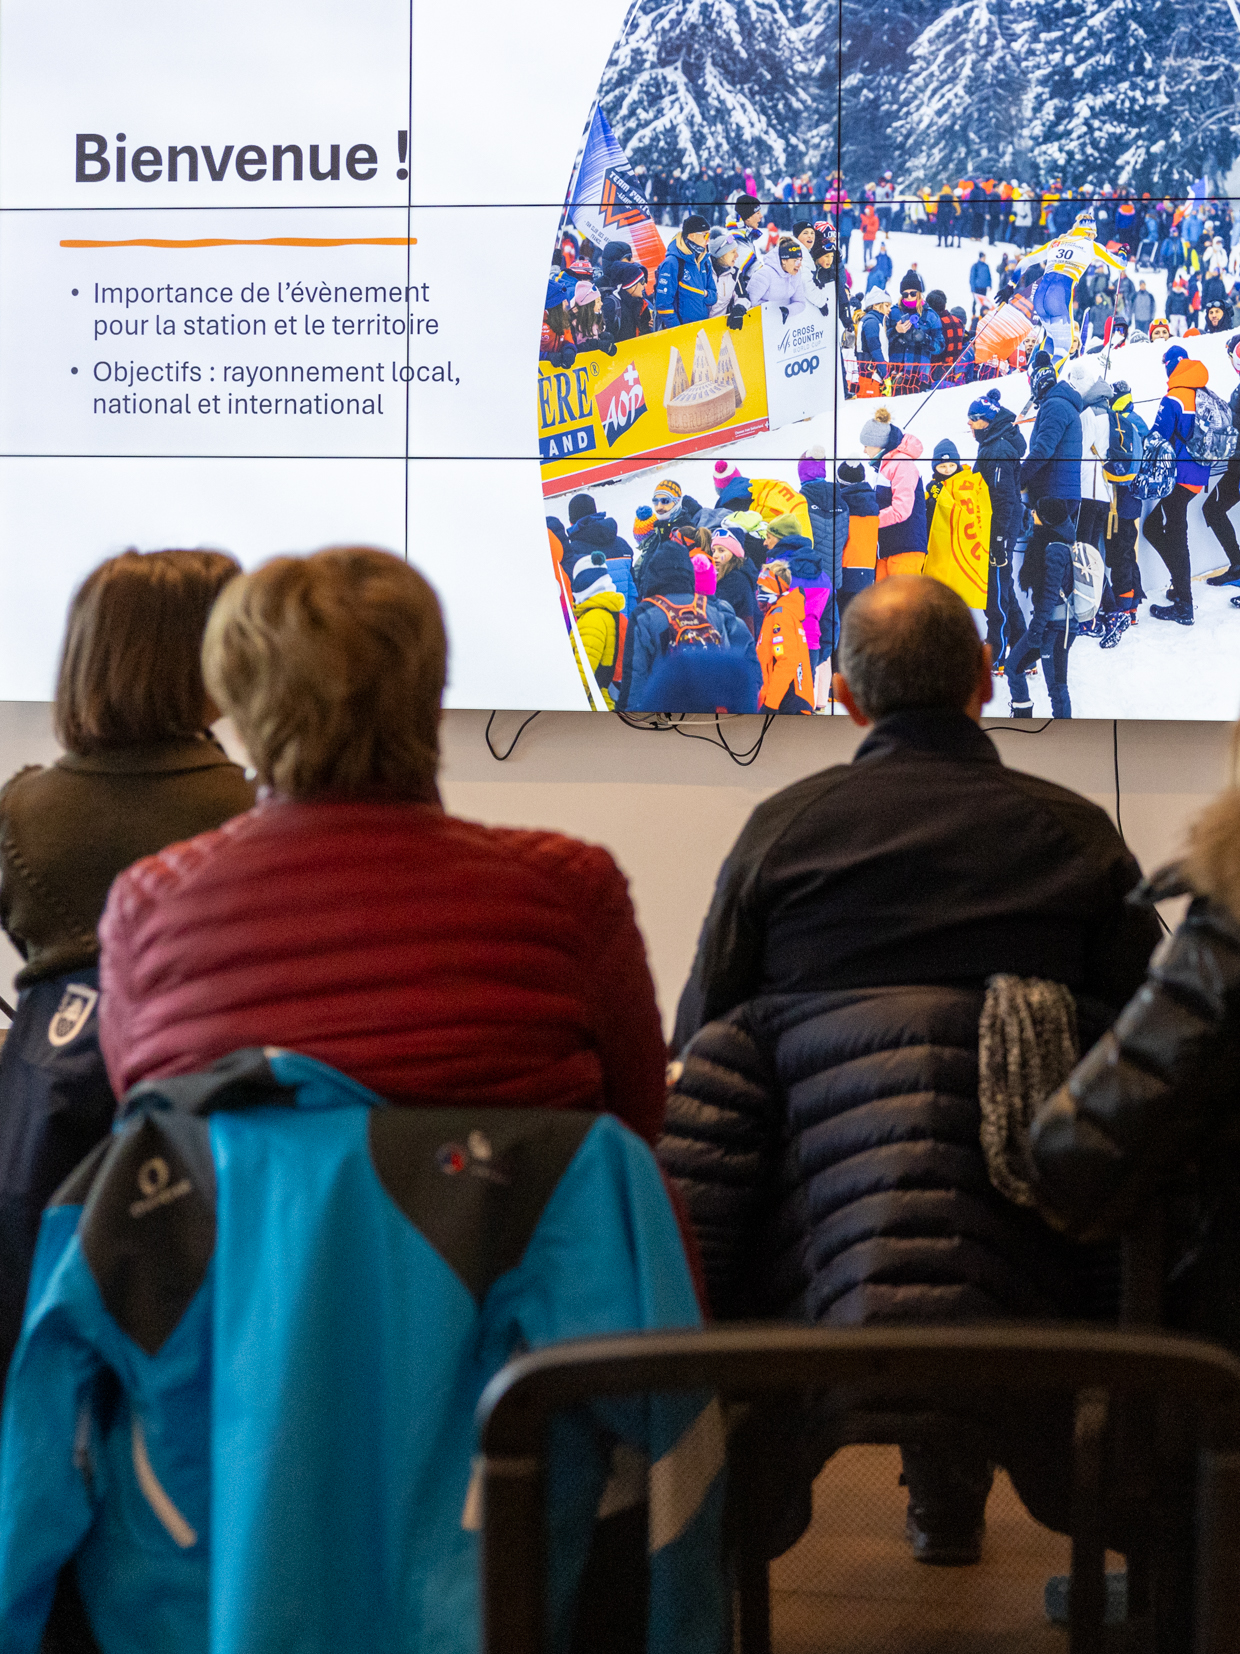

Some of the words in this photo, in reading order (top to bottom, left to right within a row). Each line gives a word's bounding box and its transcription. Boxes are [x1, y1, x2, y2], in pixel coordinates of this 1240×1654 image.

[75, 132, 378, 183] Bienvenue
[396, 130, 409, 181] !
[1055, 248, 1074, 260] 30
[94, 283, 233, 308] Importance
[240, 281, 270, 303] de
[94, 319, 148, 341] pour
[156, 315, 176, 336] la
[183, 314, 266, 336] station
[274, 316, 297, 336] et
[304, 314, 325, 336] le
[331, 314, 439, 336] territoire
[792, 324, 815, 338] CROSS
[792, 330, 824, 347] COUNTRY
[93, 361, 202, 388] Objectifs
[223, 364, 384, 387] rayonnement
[392, 361, 460, 385] local,
[784, 355, 820, 378] coop
[92, 393, 192, 414] national
[197, 395, 221, 414] et
[228, 393, 384, 414] international
[602, 384, 644, 435] AOP
[539, 431, 588, 458] AND
